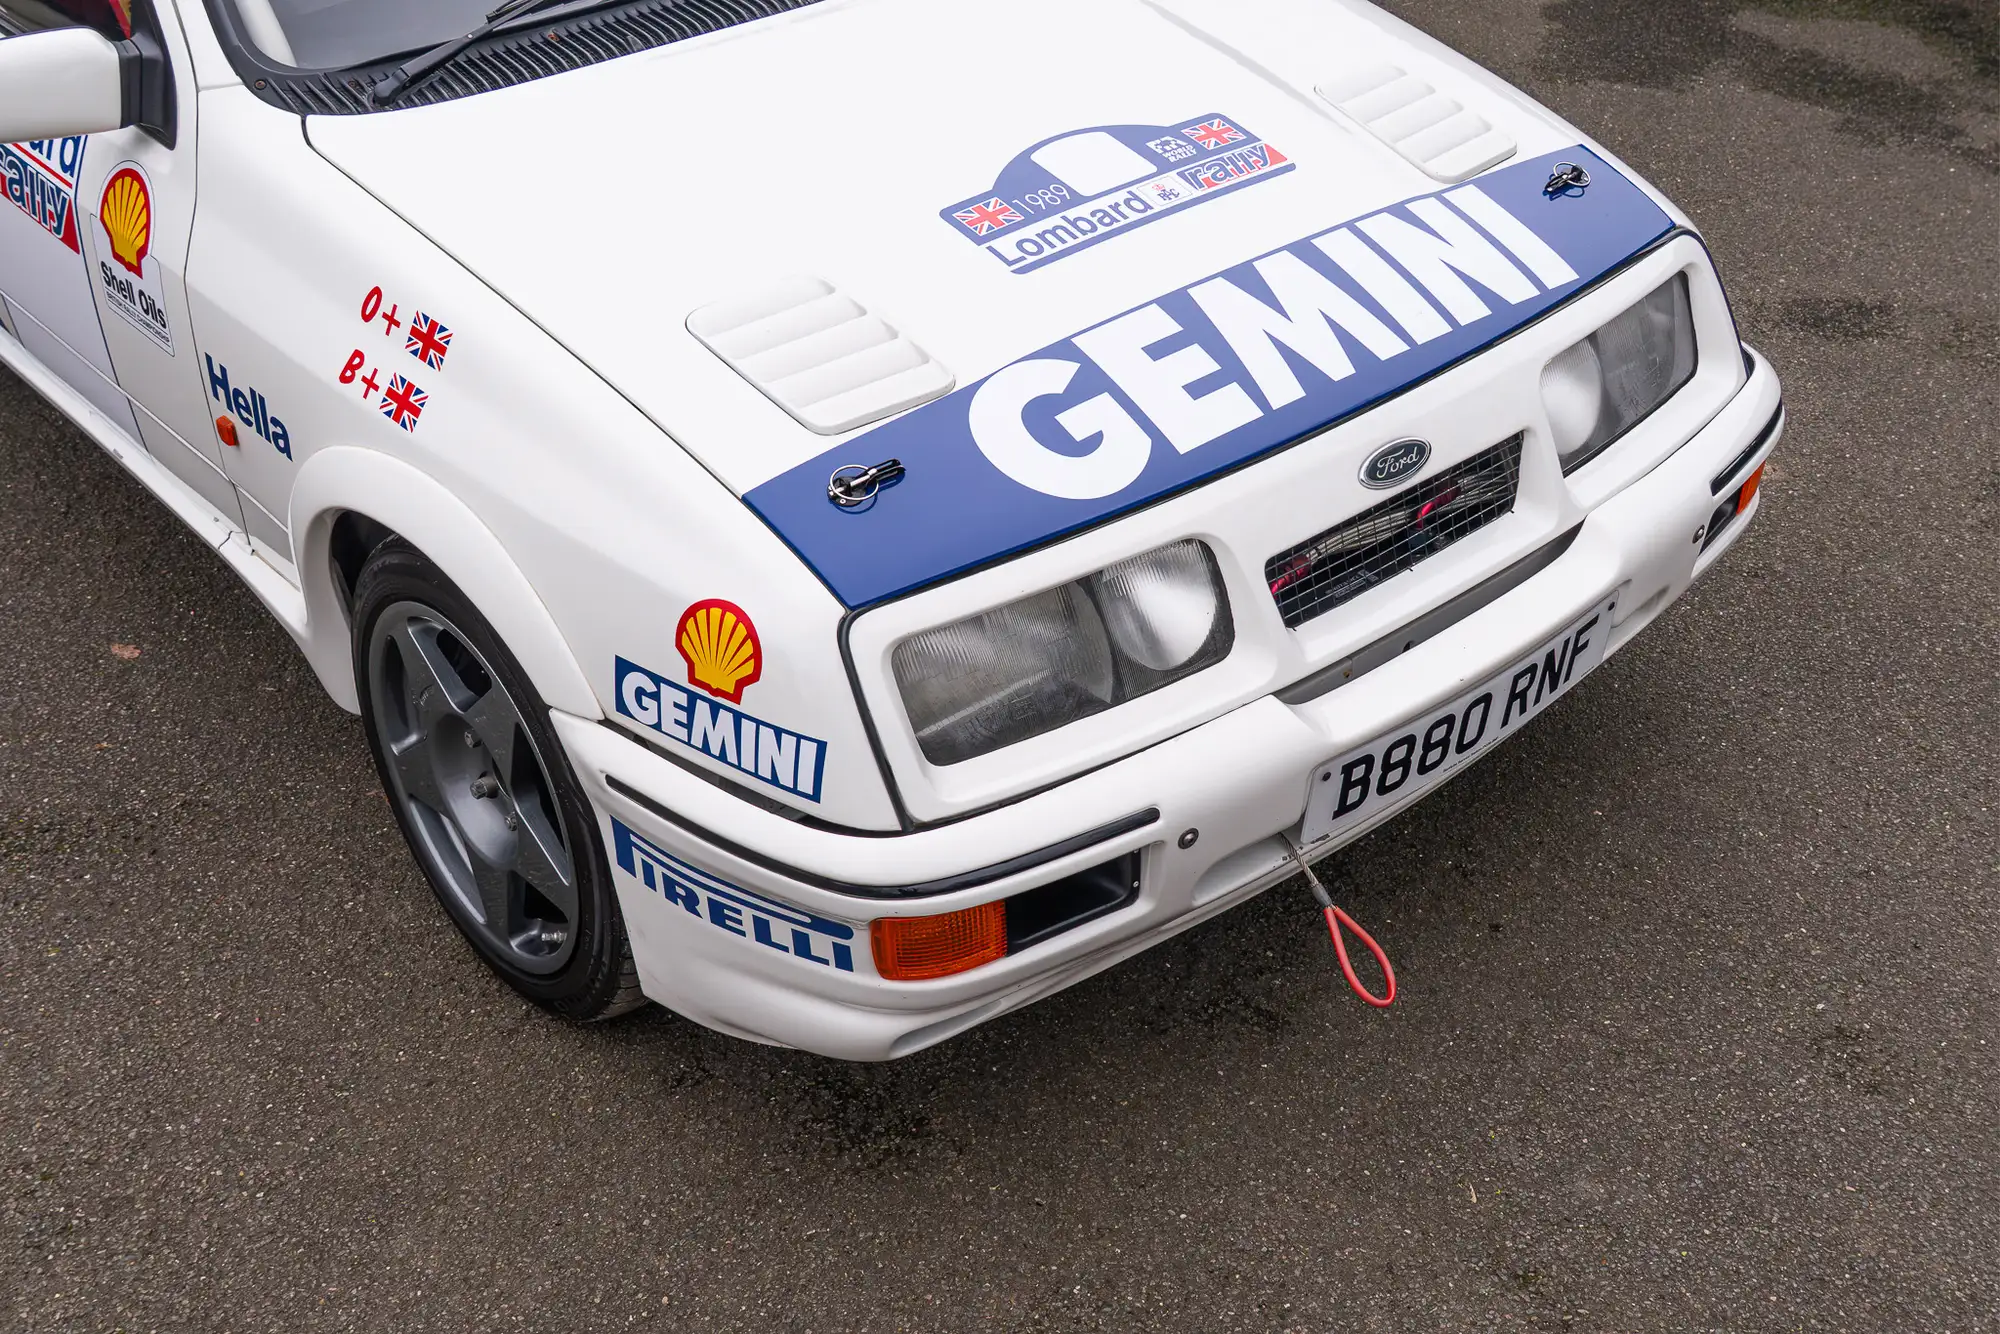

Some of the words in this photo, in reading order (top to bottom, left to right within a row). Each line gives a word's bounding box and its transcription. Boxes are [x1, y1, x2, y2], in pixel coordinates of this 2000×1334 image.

[0, 146, 70, 238] ally
[1012, 184, 1071, 214] 1989
[1162, 144, 1194, 158] WORLD
[1167, 147, 1197, 162] RALLY
[985, 190, 1154, 267] Lombard
[1185, 144, 1271, 190] rally
[101, 261, 136, 307] Shell
[138, 289, 167, 329] Oils
[968, 184, 1580, 500] GEMINI
[204, 352, 293, 462] Hella
[1376, 446, 1420, 478] Ford
[622, 671, 818, 796] GEMINI
[1332, 692, 1493, 821] B880
[1500, 613, 1600, 729] RNF
[609, 813, 855, 973] PIRELLI
